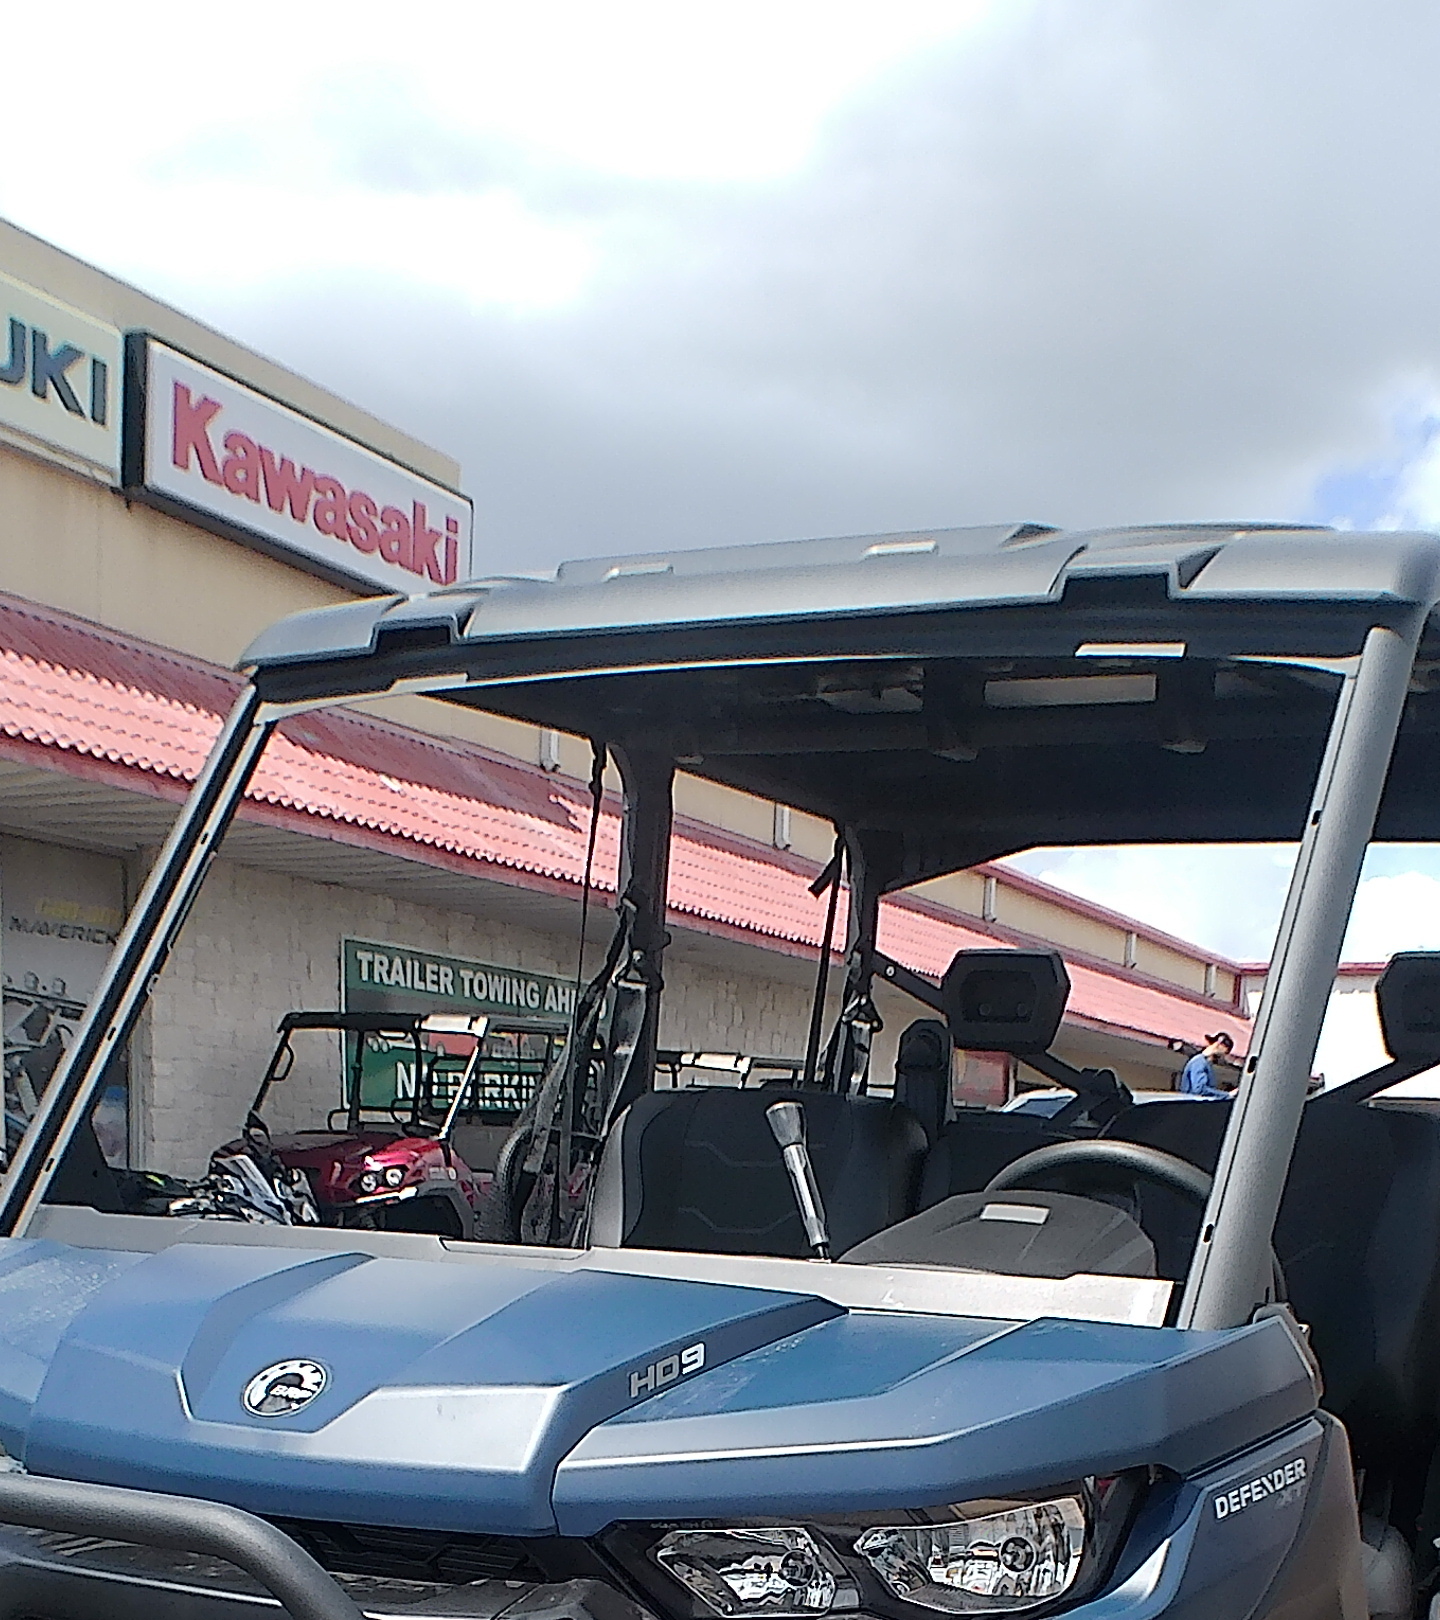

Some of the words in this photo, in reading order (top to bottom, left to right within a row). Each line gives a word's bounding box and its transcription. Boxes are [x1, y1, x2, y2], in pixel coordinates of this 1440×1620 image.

[172, 379, 459, 586] Kawasaki
[357, 951, 454, 996] TRAILER
[460, 970, 540, 1010] TOWING
[630, 1342, 705, 1398] HD9
[1215, 1458, 1306, 1519] DEFENDER
